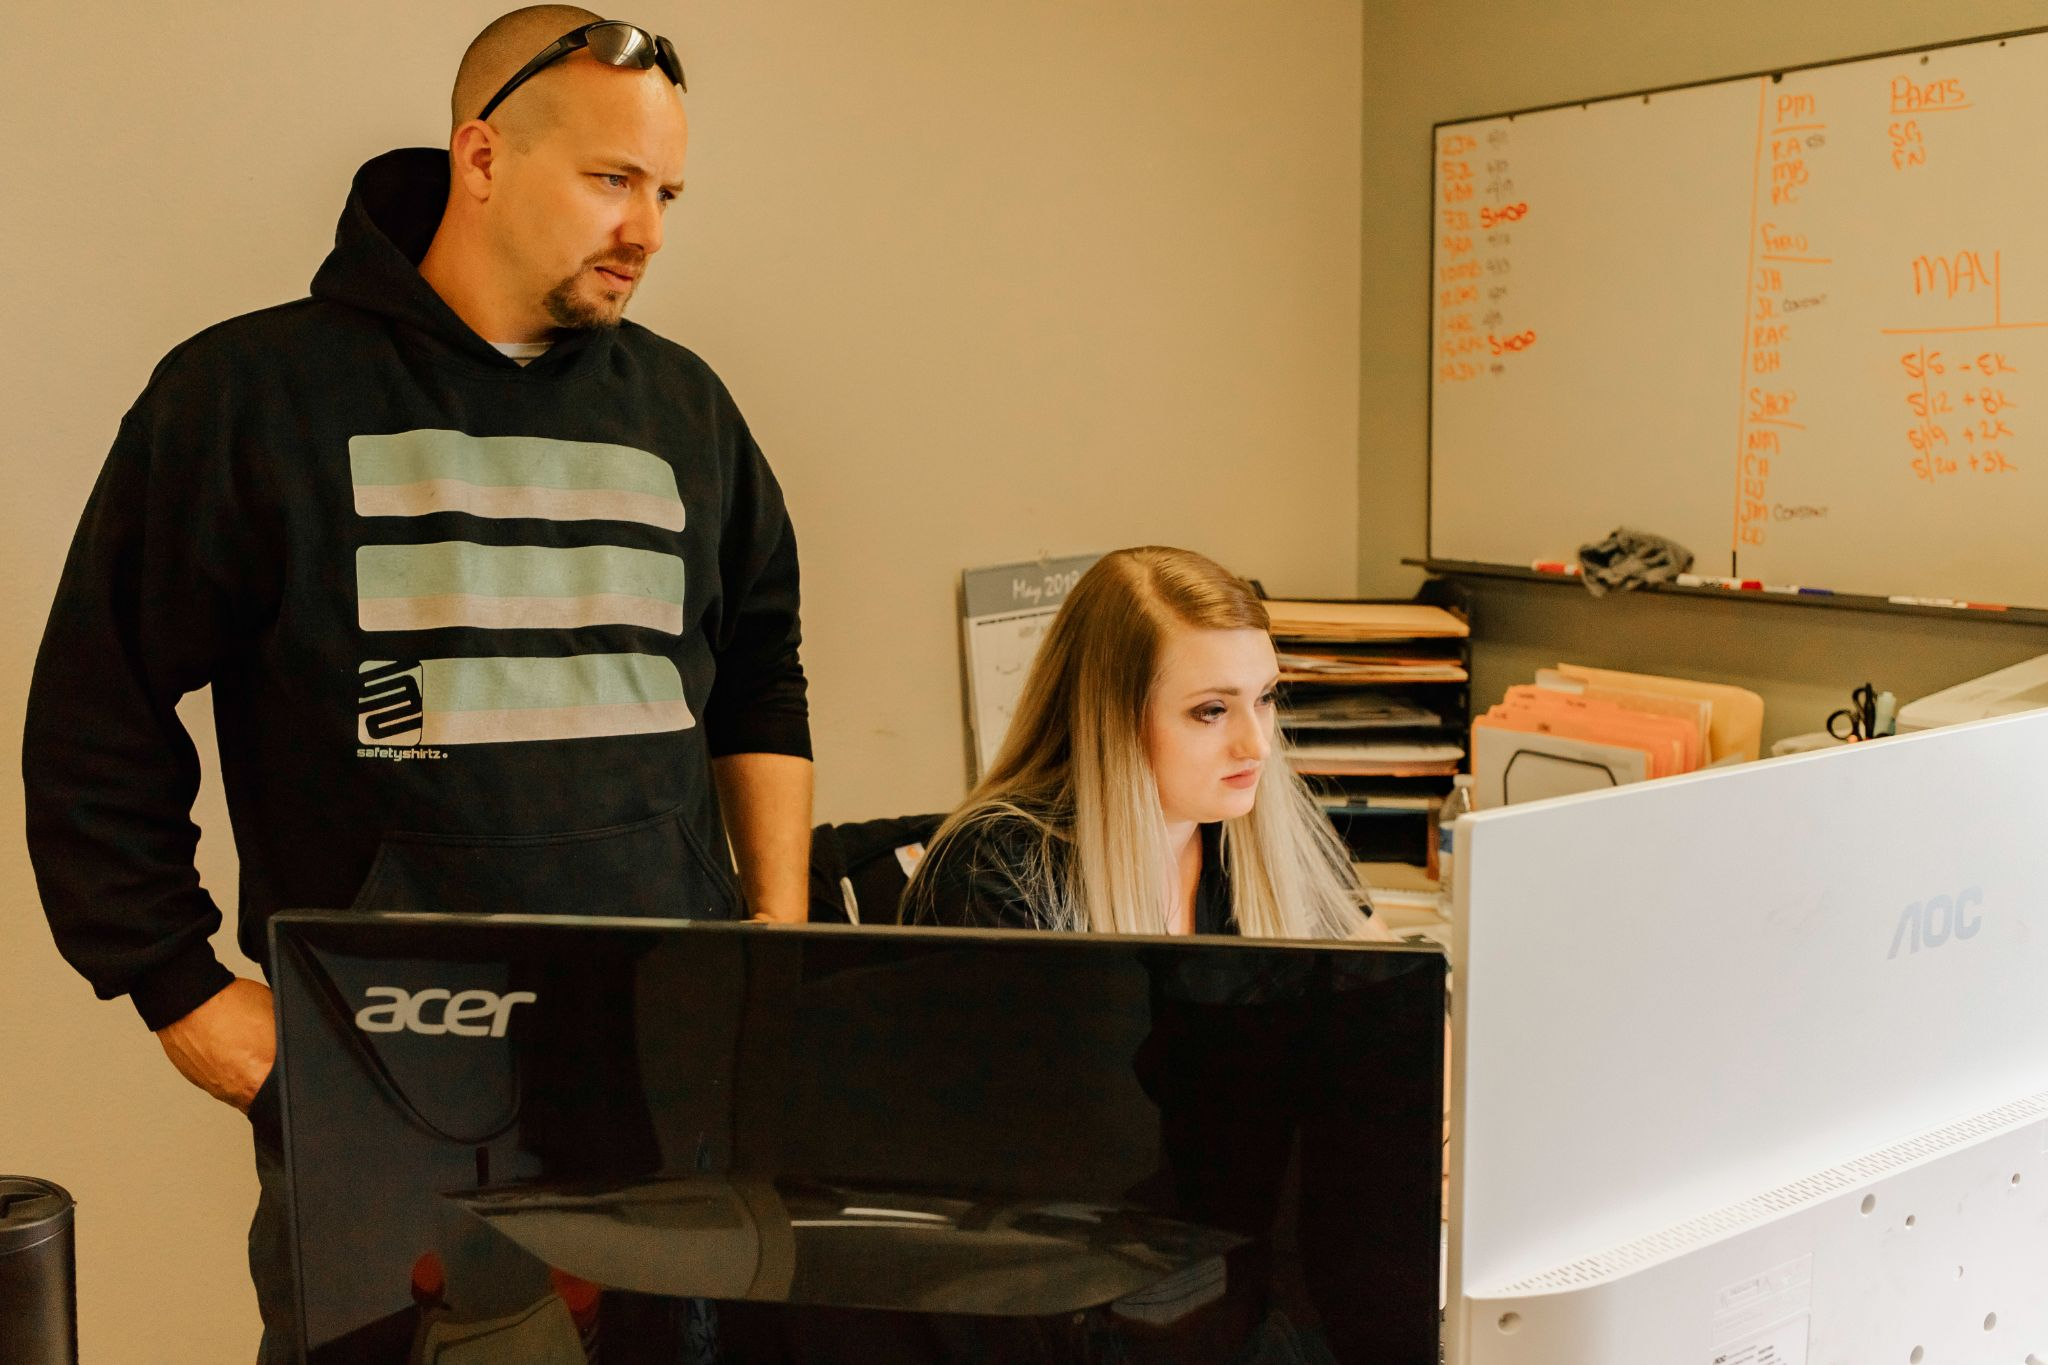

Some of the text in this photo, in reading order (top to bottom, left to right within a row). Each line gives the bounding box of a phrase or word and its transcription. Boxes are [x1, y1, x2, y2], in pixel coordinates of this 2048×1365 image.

[1890, 74, 1966, 110] PARTS
[1911, 249, 2000, 305] MAY
[1011, 578, 1042, 606] May
[355, 986, 538, 1038] acer
